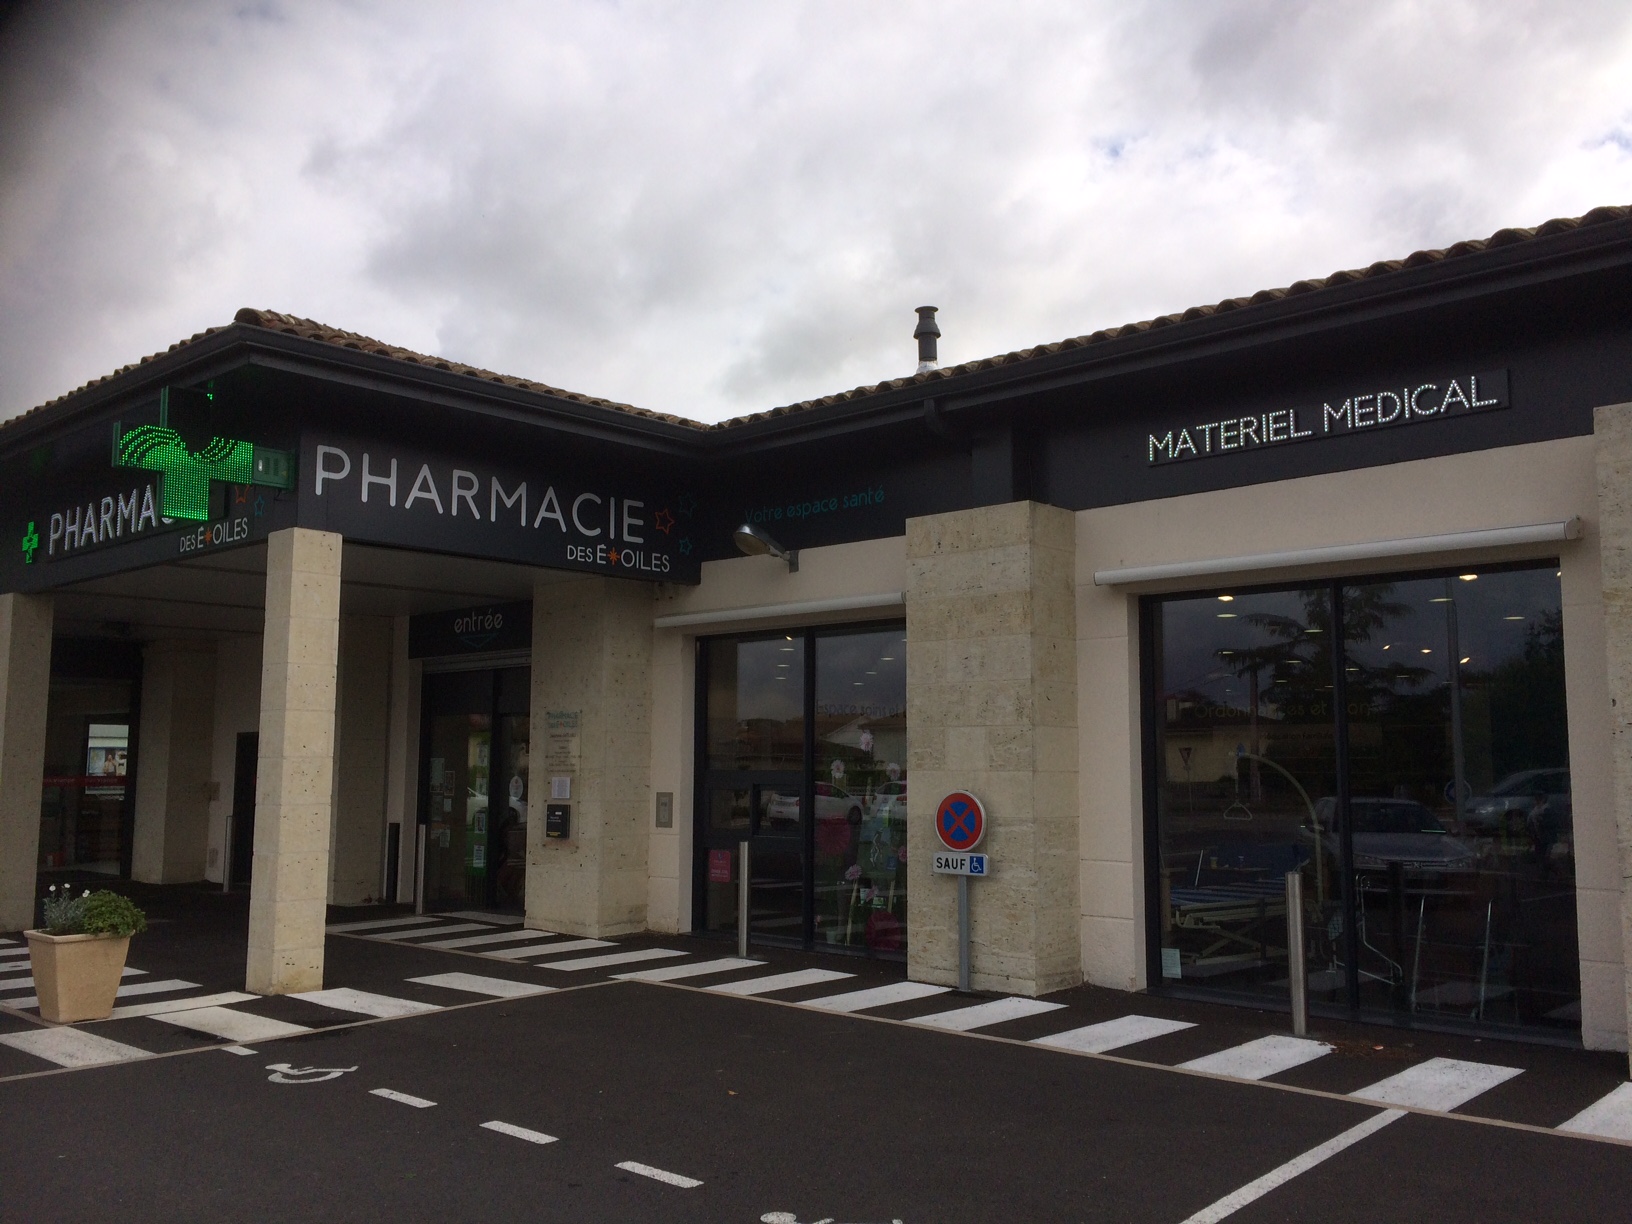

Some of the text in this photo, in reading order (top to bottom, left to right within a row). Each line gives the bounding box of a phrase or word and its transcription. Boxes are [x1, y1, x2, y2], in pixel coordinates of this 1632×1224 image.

[1148, 375, 1499, 462] MATERIEL MEDICAL
[314, 444, 646, 544] PHARMACIE
[744, 485, 885, 524] Votre espace santé
[49, 484, 177, 556] PHARMA
[179, 534, 196, 553] DES
[567, 545, 594, 562] DES
[453, 609, 503, 634] entrée
[936, 856, 967, 870] SAUF
